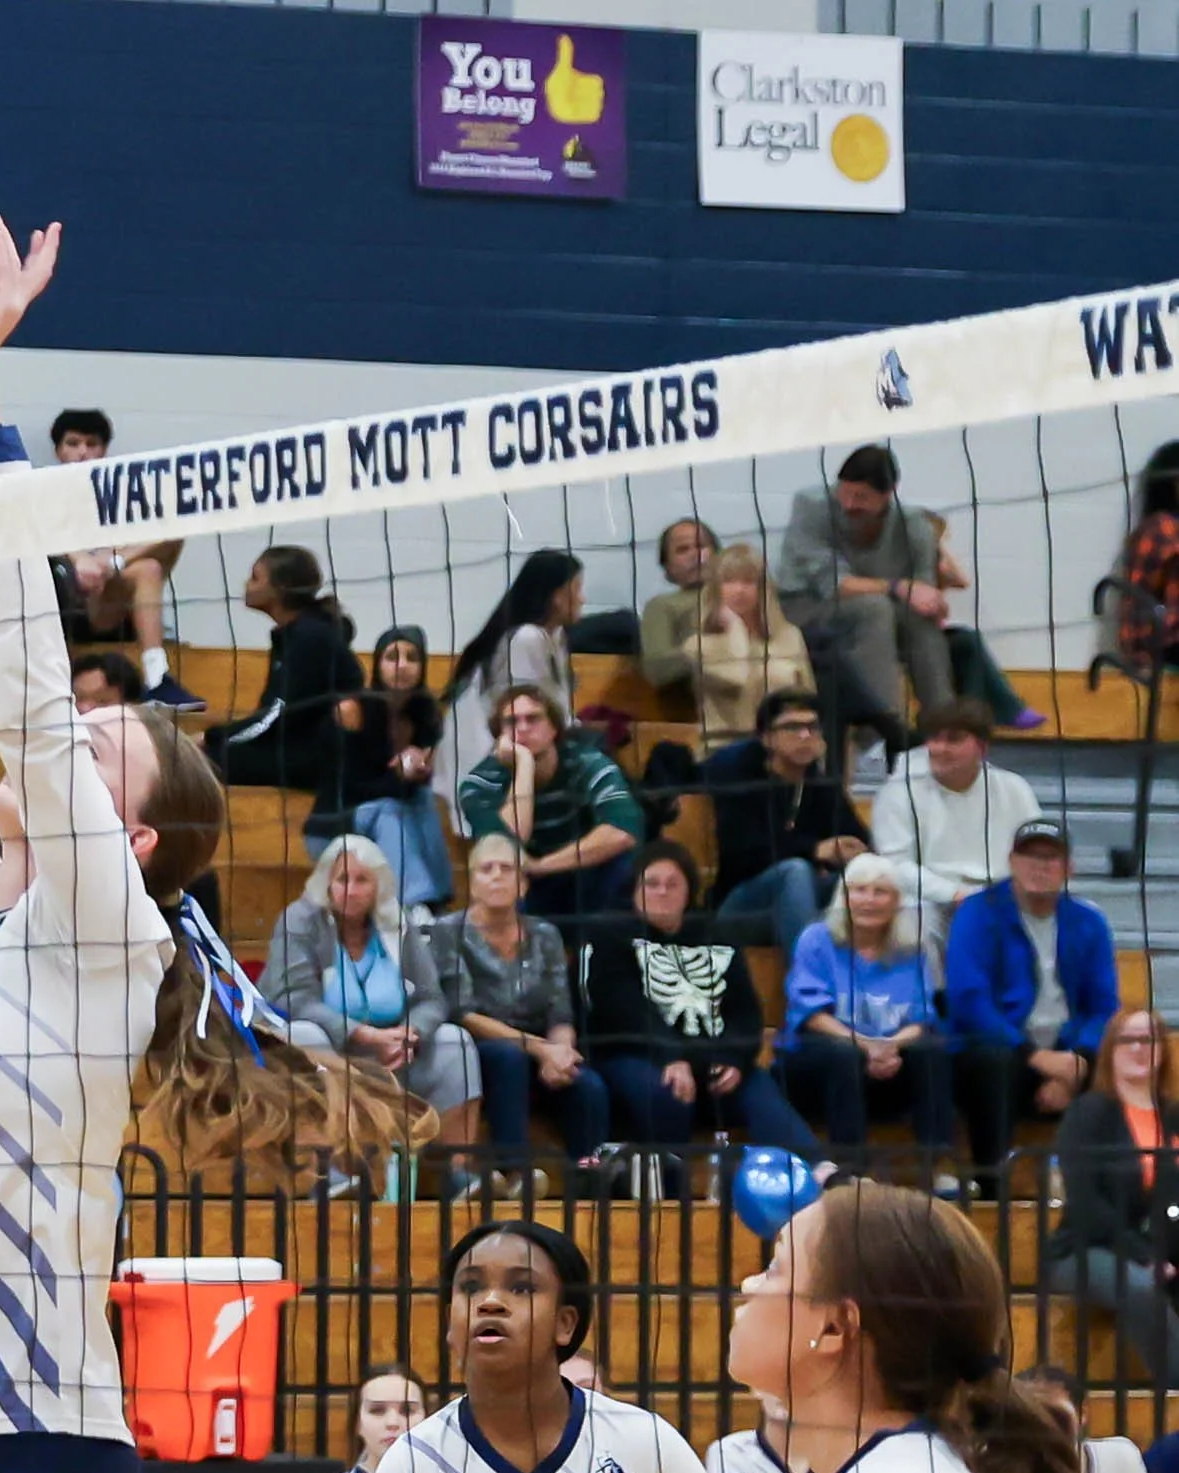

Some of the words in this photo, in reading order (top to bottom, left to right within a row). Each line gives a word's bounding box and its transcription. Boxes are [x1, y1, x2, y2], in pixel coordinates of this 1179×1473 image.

[441, 41, 536, 92] You
[710, 61, 888, 109] Clarkston
[441, 86, 536, 124] Belong
[716, 108, 820, 165] Legal
[90, 431, 327, 527] WATERFORD
[348, 409, 468, 489] MOTT
[487, 370, 719, 470] CORSAIRS
